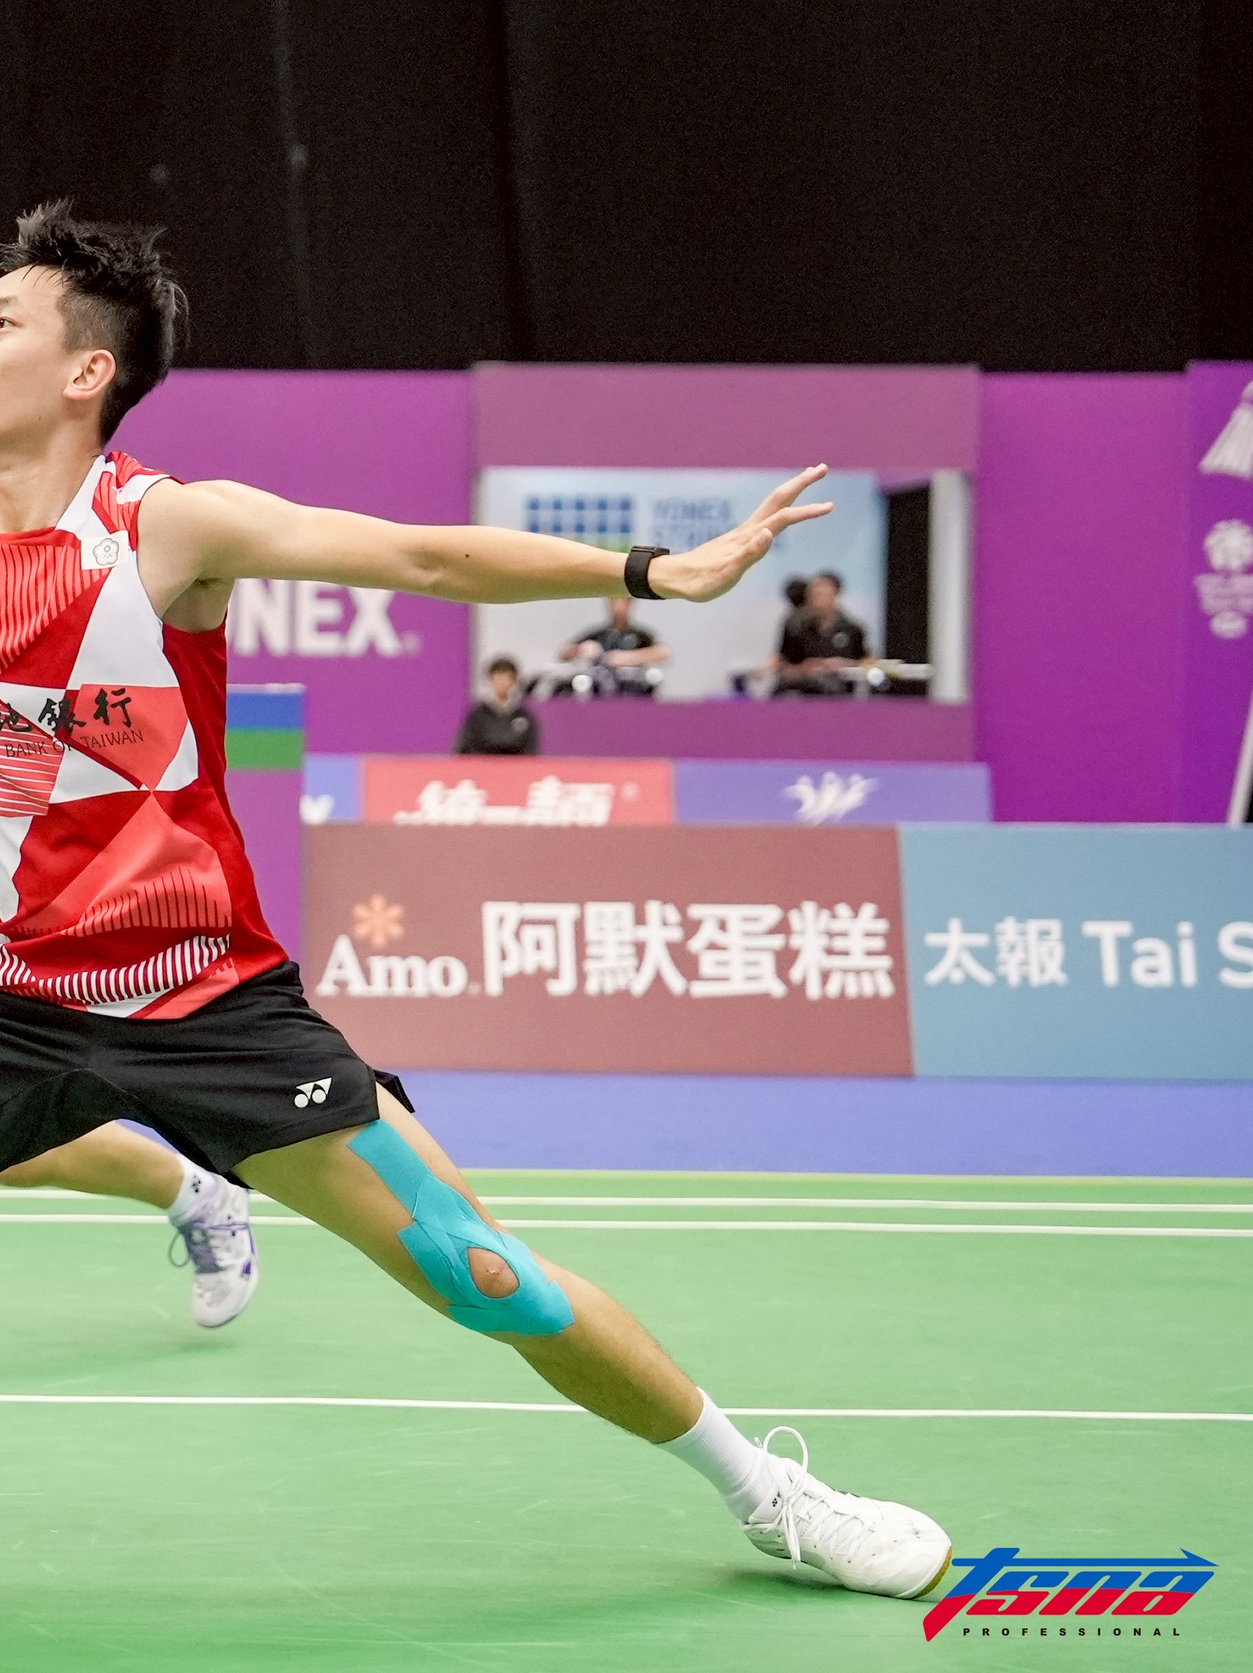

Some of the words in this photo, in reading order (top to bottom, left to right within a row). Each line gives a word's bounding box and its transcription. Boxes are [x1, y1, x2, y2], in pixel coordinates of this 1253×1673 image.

[226, 578, 404, 659] NEX
[4, 740, 49, 758] BANK
[80, 729, 144, 750] TAIWAN
[315, 934, 469, 998] Amo
[481, 899, 896, 1000] 阿默蛋糕
[923, 916, 1070, 989] 太報
[1081, 919, 1198, 989] Tai
